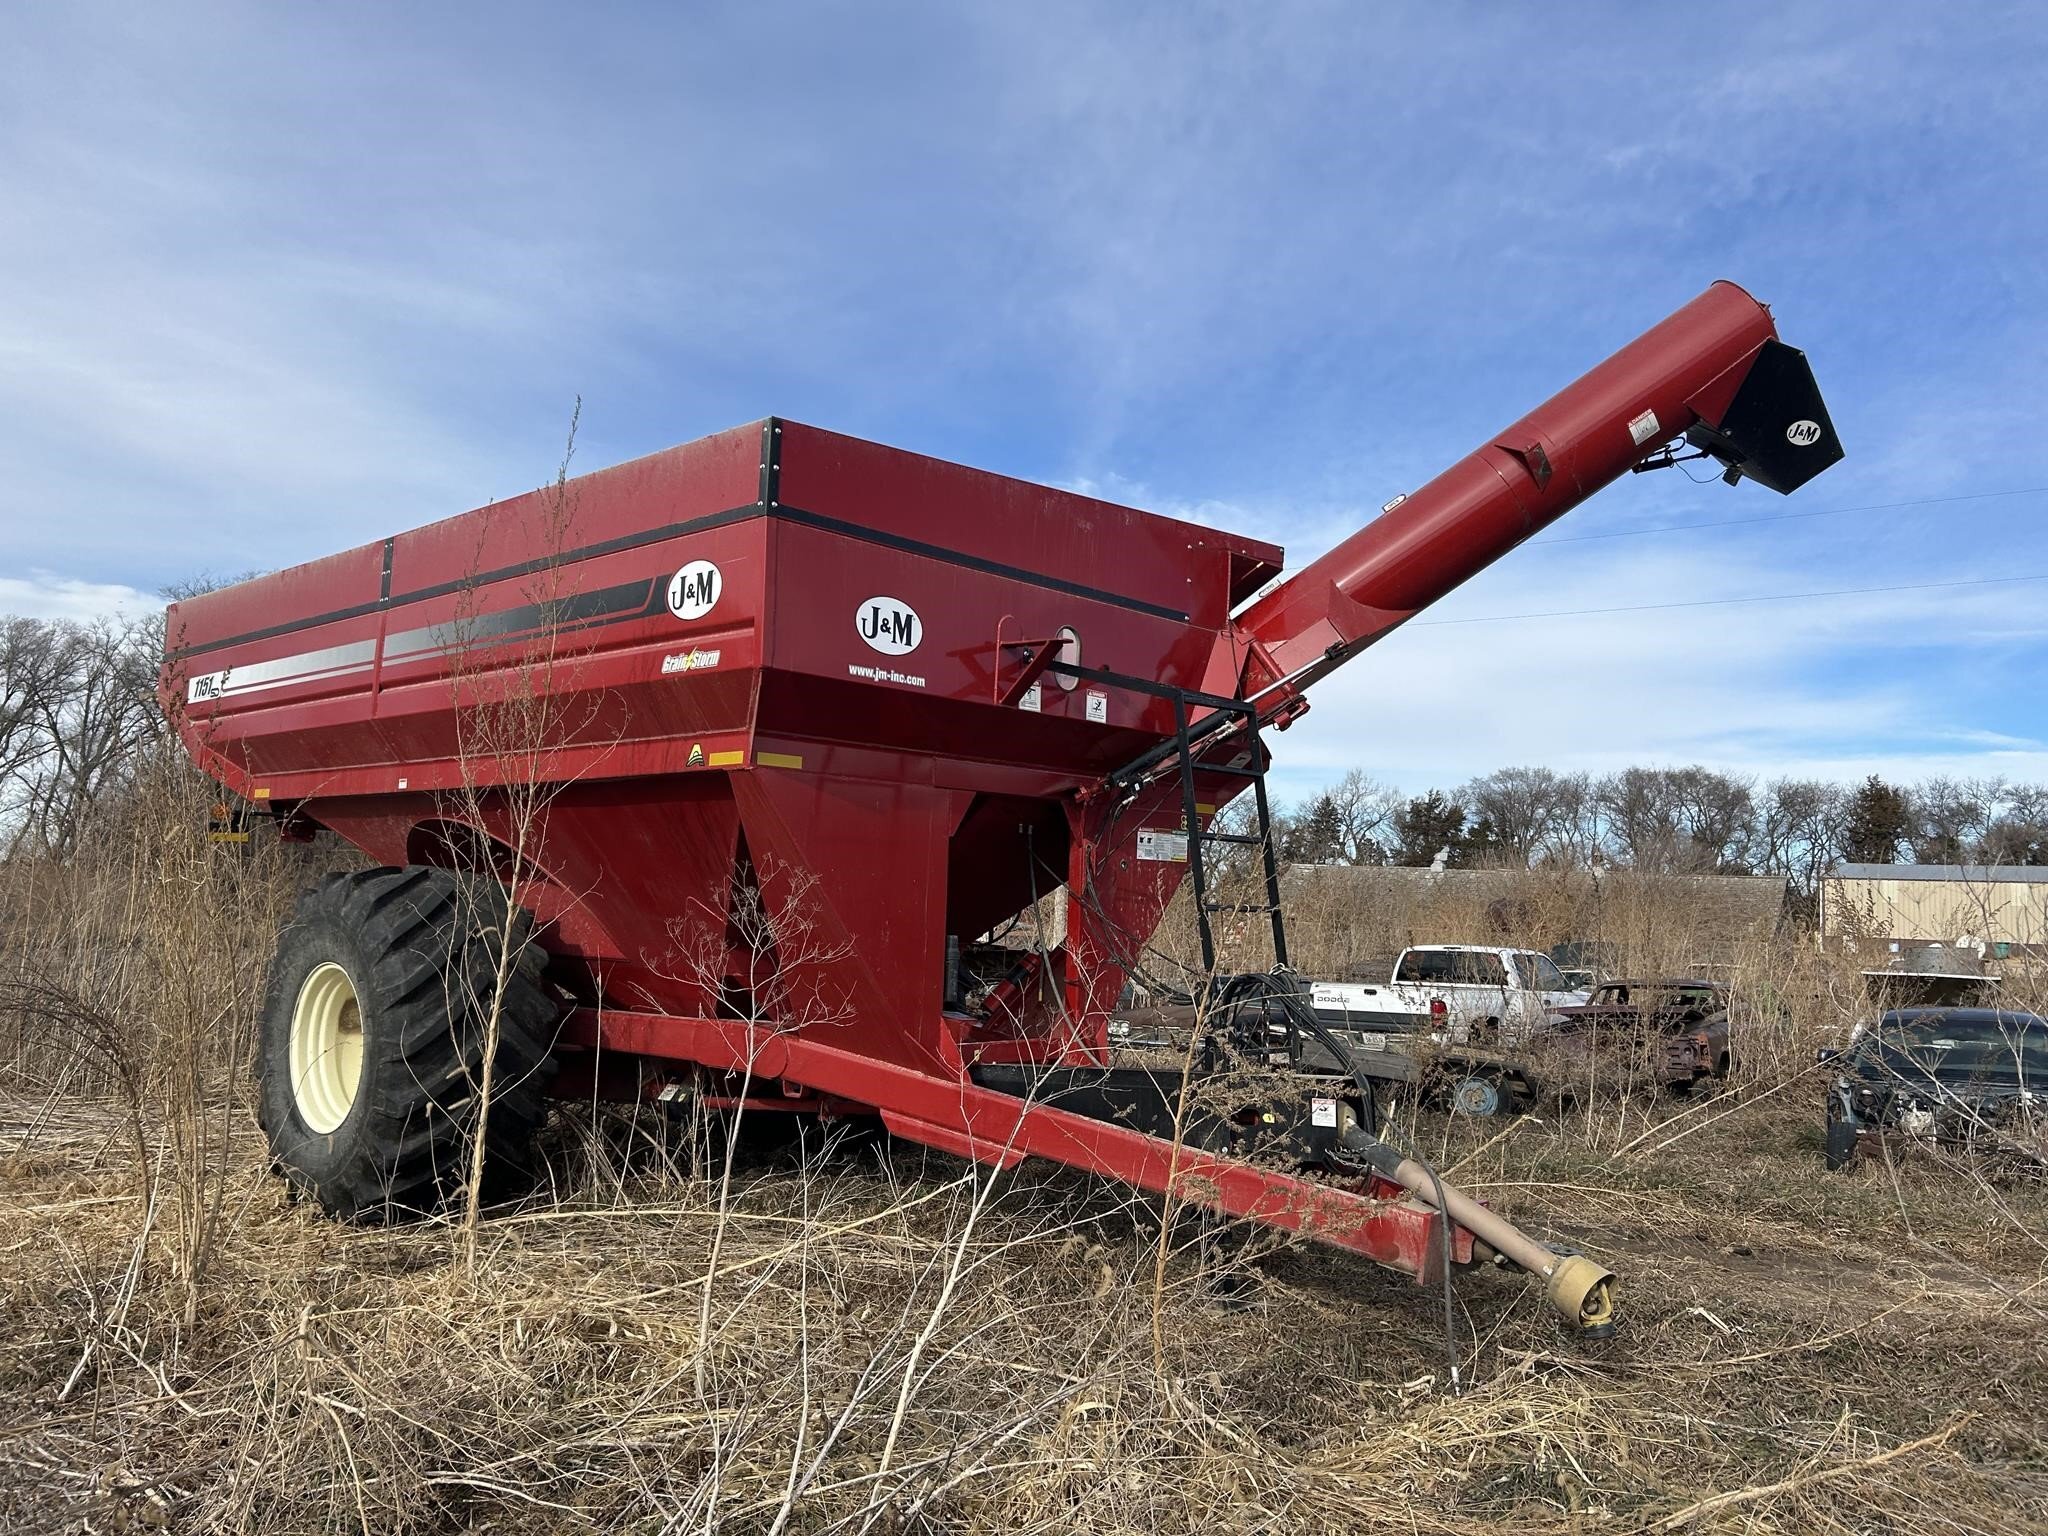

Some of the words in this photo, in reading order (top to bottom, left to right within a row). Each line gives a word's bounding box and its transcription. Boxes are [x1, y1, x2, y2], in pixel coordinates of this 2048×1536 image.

[1788, 424, 1819, 442] J&M
[672, 569, 715, 611] J&M
[861, 605, 914, 648] J&M
[661, 652, 689, 675] Grain
[691, 649, 720, 670] Storm
[848, 663, 926, 688] www.jm-inc.com
[1316, 996, 1350, 1004] DODGE
